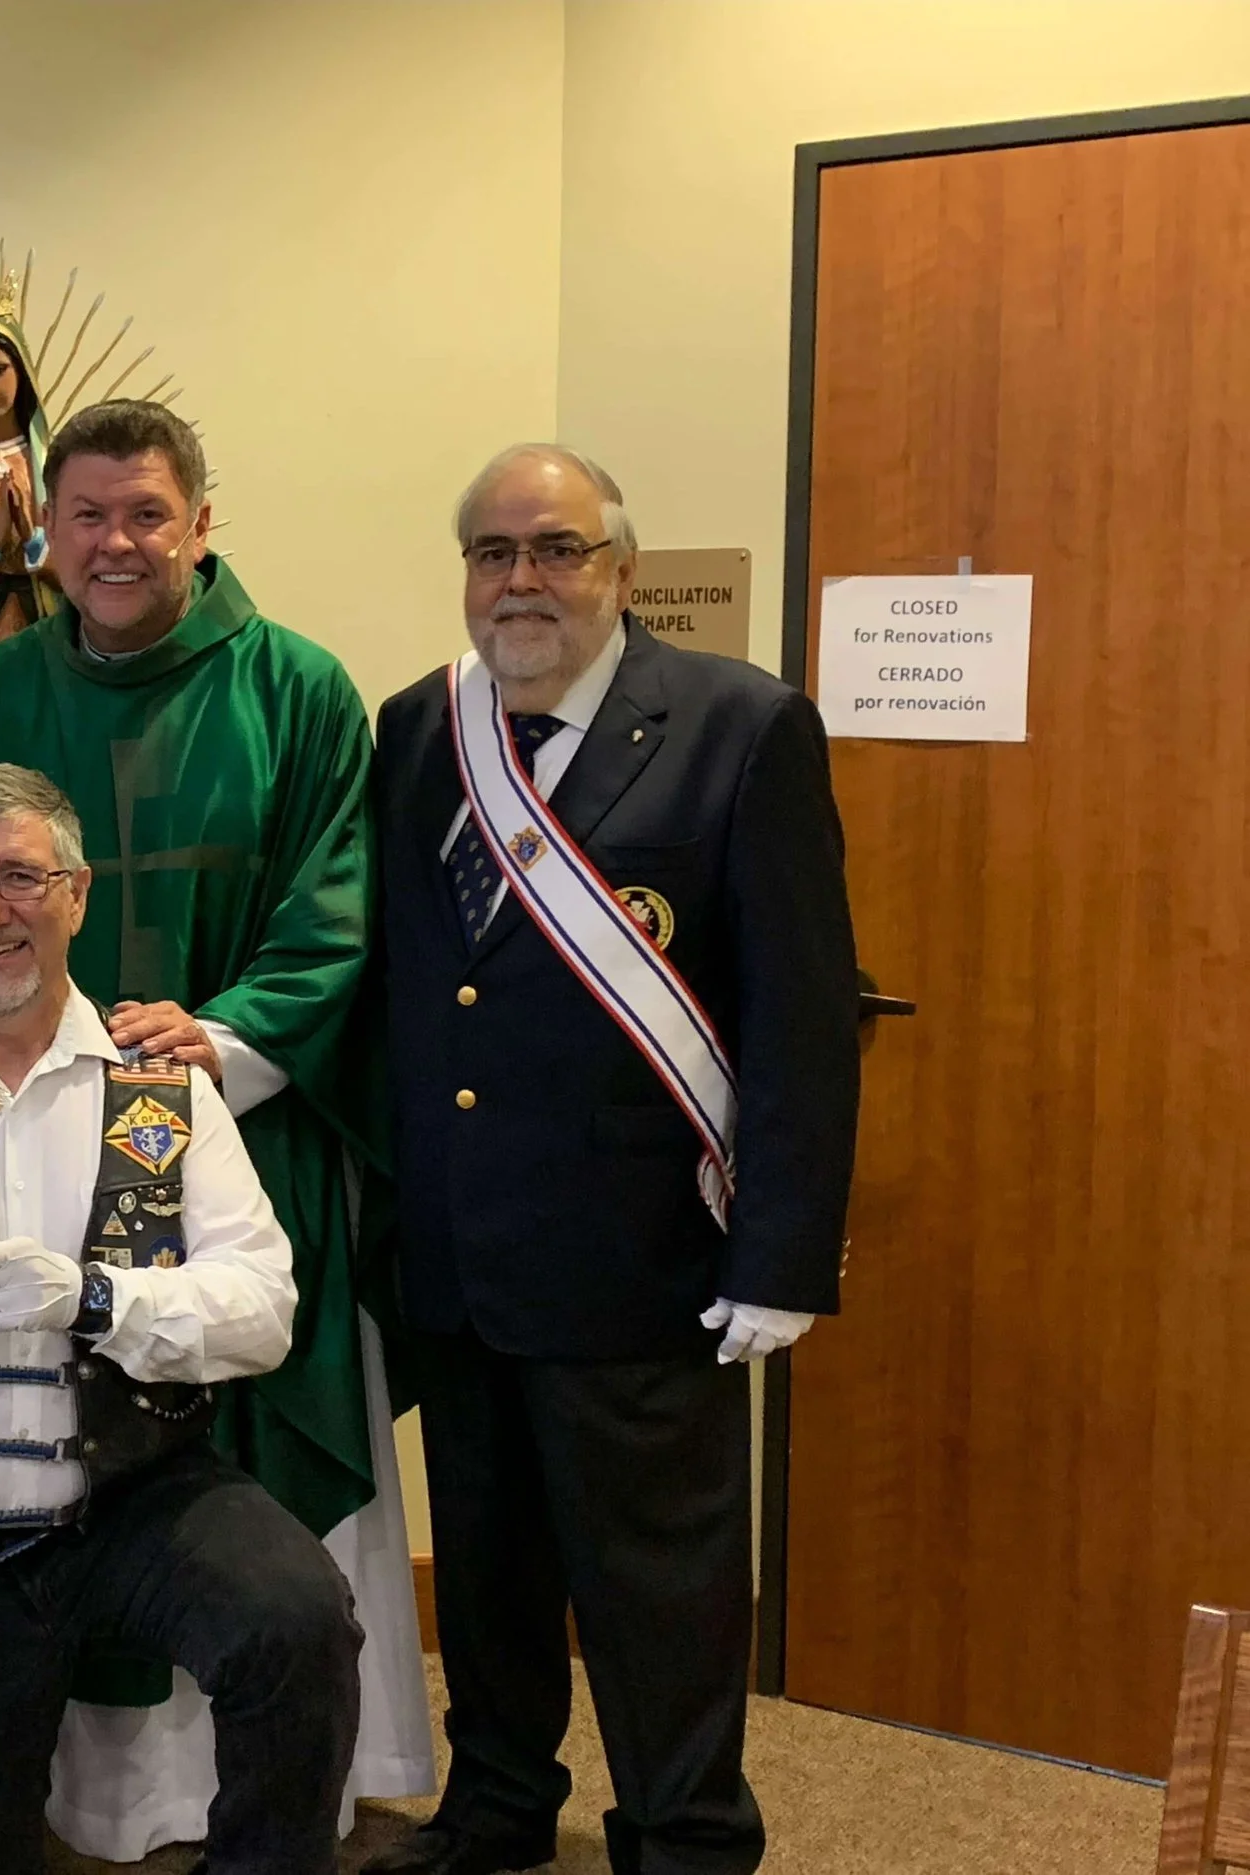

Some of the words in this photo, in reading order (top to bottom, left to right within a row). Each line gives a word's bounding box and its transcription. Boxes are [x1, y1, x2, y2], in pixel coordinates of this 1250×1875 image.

[631, 587, 732, 605] ONCILIATION
[890, 600, 958, 616] CLOSED
[854, 627, 878, 643] for
[884, 627, 993, 644] Renovations
[878, 667, 964, 683] CERRADO
[854, 697, 884, 712] por
[888, 695, 986, 712] renovación
[129, 1115, 138, 1126] K
[158, 1113, 168, 1123] C
